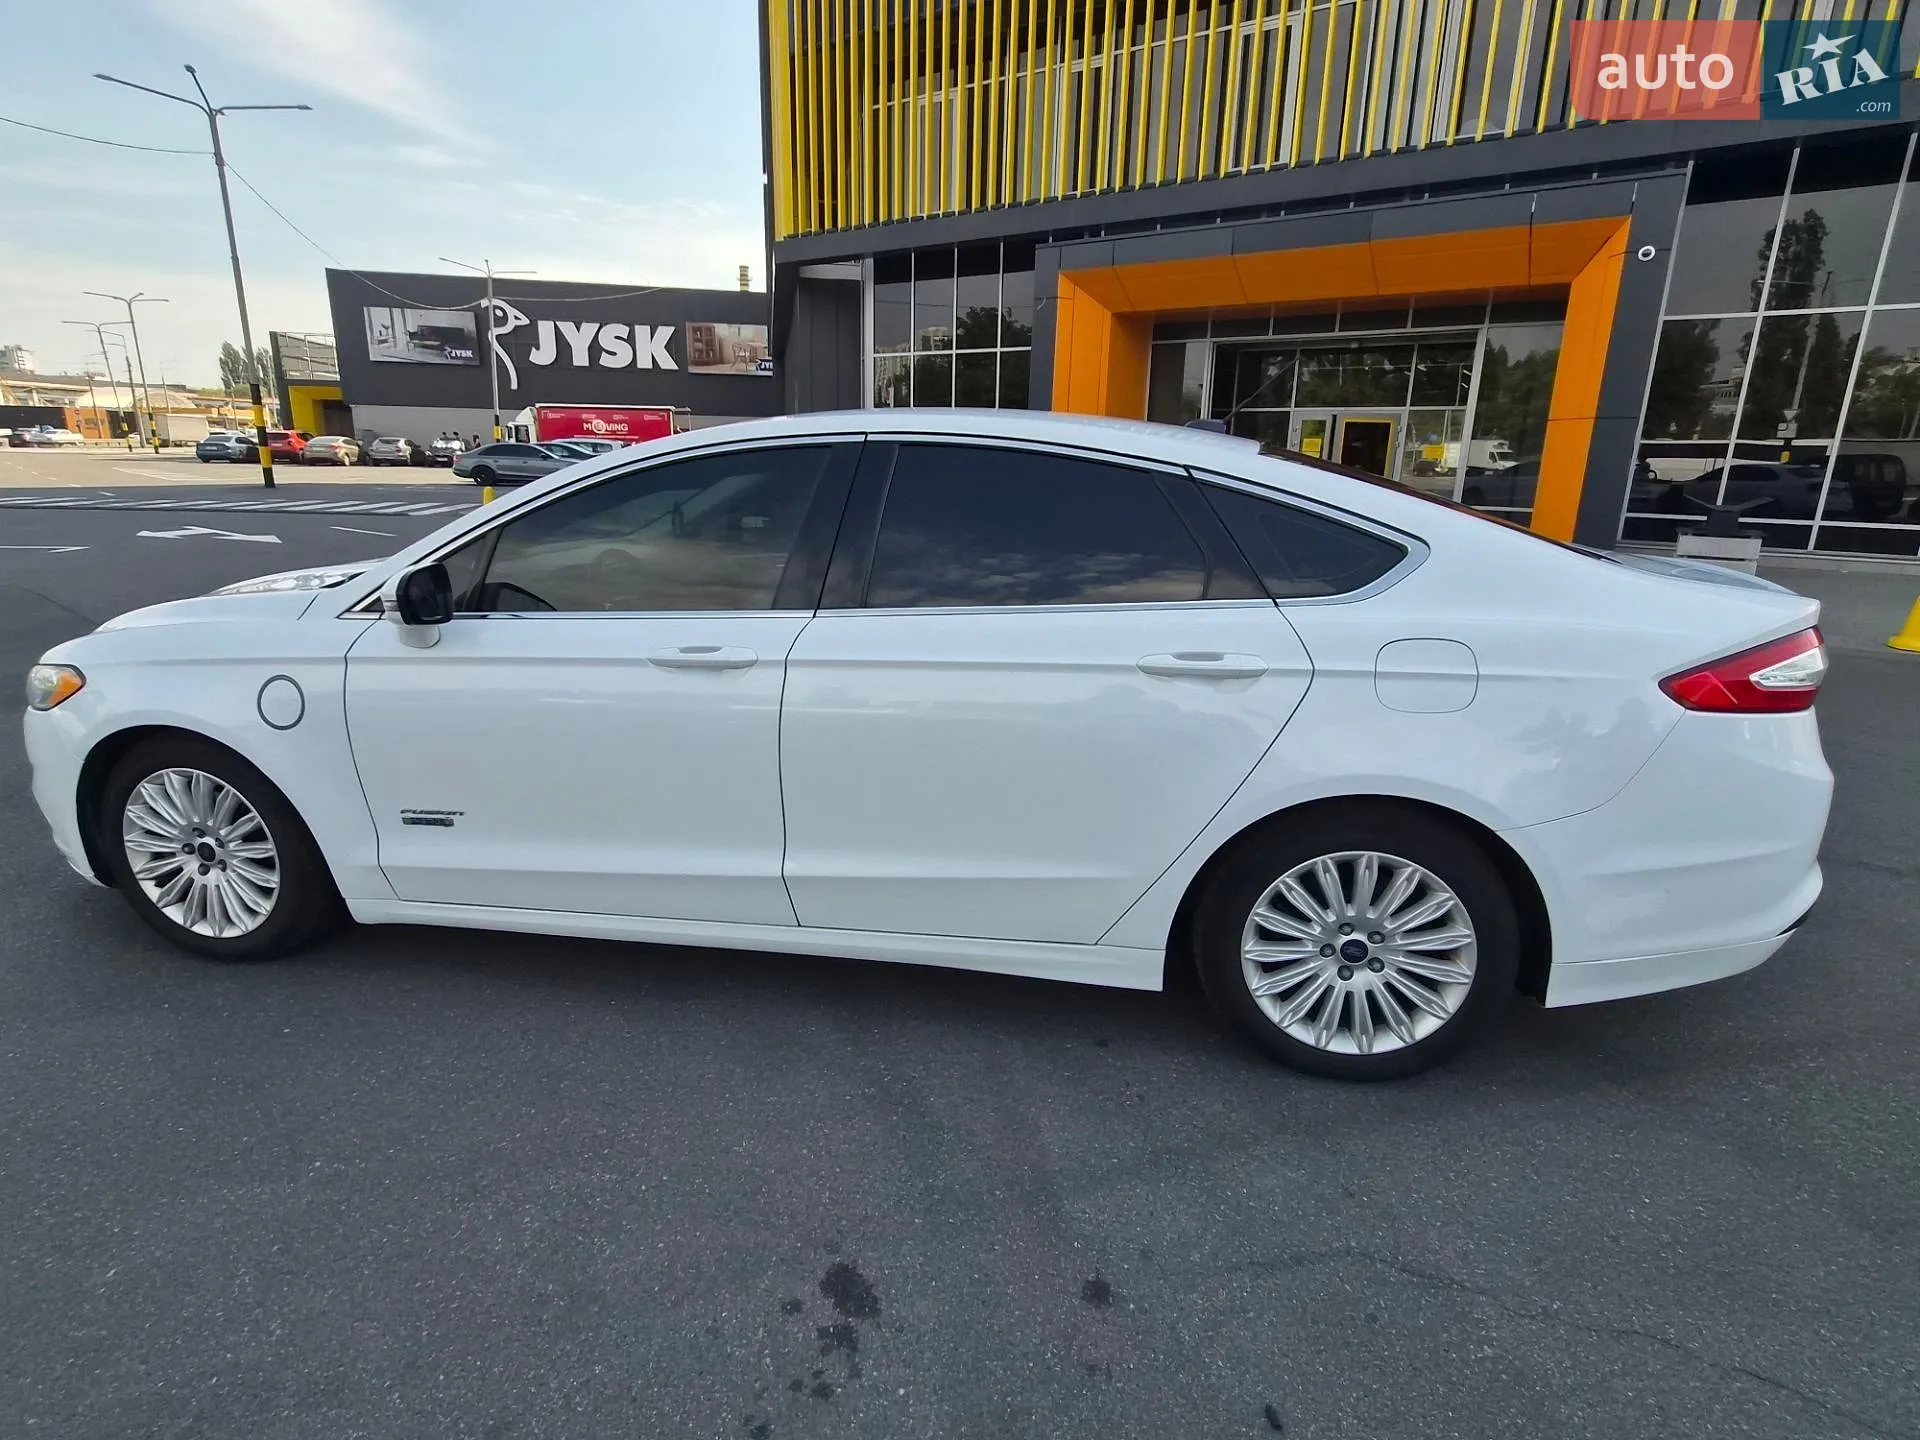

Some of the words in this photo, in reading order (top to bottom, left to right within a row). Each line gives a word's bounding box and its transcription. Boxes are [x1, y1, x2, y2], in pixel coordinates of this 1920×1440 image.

[529, 320, 679, 369] JYSK
[450, 349, 473, 358] JYSK
[583, 419, 628, 434] MOVING
